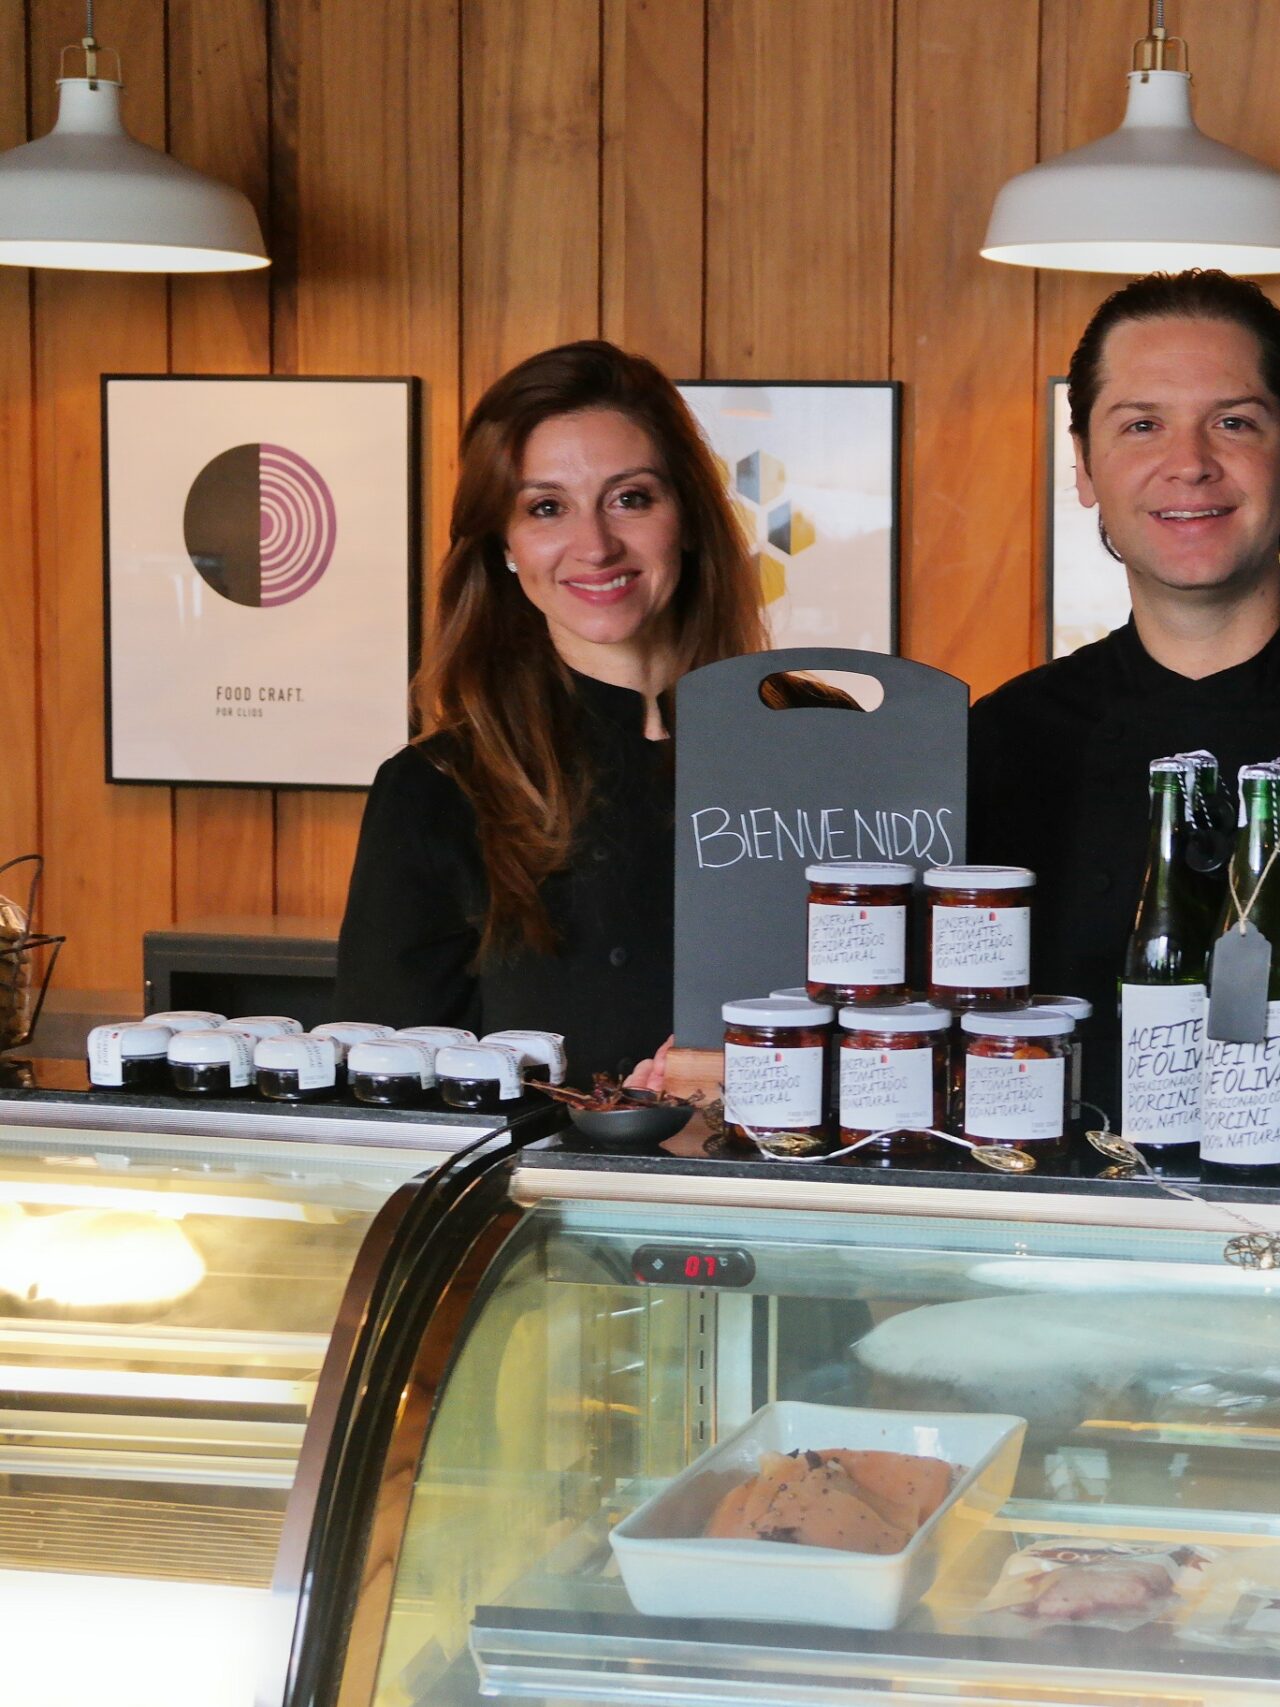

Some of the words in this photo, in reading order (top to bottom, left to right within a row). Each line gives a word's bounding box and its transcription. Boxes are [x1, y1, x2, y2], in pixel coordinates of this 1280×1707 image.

[216, 686, 251, 701] FOOD
[691, 807, 953, 868] BIENVENIDOS
[1128, 1018, 1203, 1051] ACEITE
[1127, 1053, 1152, 1079] DE
[1152, 1048, 1201, 1077] OLIV
[1128, 1086, 1199, 1113] PORCINI
[1157, 1107, 1201, 1129] NATUR
